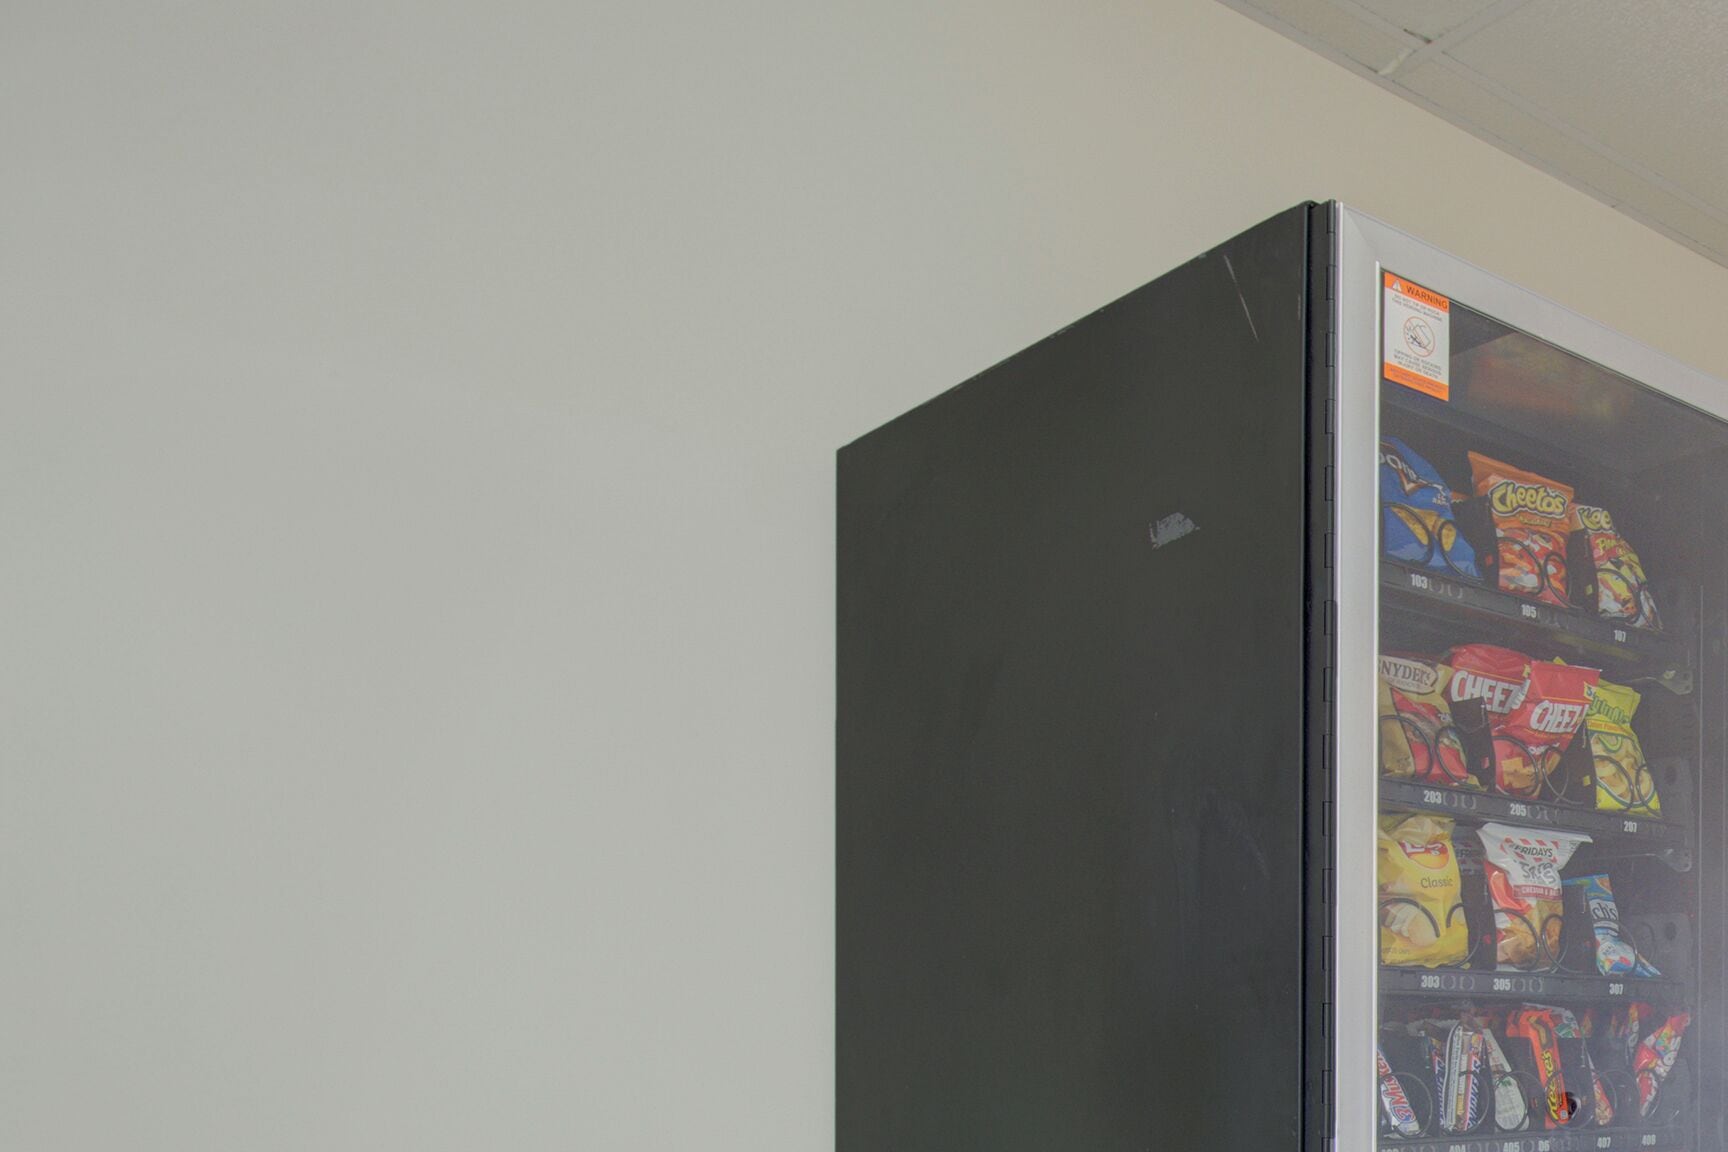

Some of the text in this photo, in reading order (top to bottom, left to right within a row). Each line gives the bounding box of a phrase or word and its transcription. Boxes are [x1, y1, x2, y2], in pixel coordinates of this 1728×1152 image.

[1406, 284, 1448, 309] WARNING
[1490, 480, 1568, 517] Cheetos
[1410, 573, 1428, 589] 103
[1521, 603, 1537, 619] 105
[1423, 789, 1442, 804] 203
[1510, 803, 1526, 816] 205
[1623, 821, 1637, 832] 207
[1420, 876, 1453, 889] Classic
[1421, 975, 1440, 988] 303
[1493, 978, 1510, 990] 305
[1609, 983, 1623, 995] 307
[1503, 1141, 1519, 1152] 405
[1596, 1136, 1611, 1148] 407
